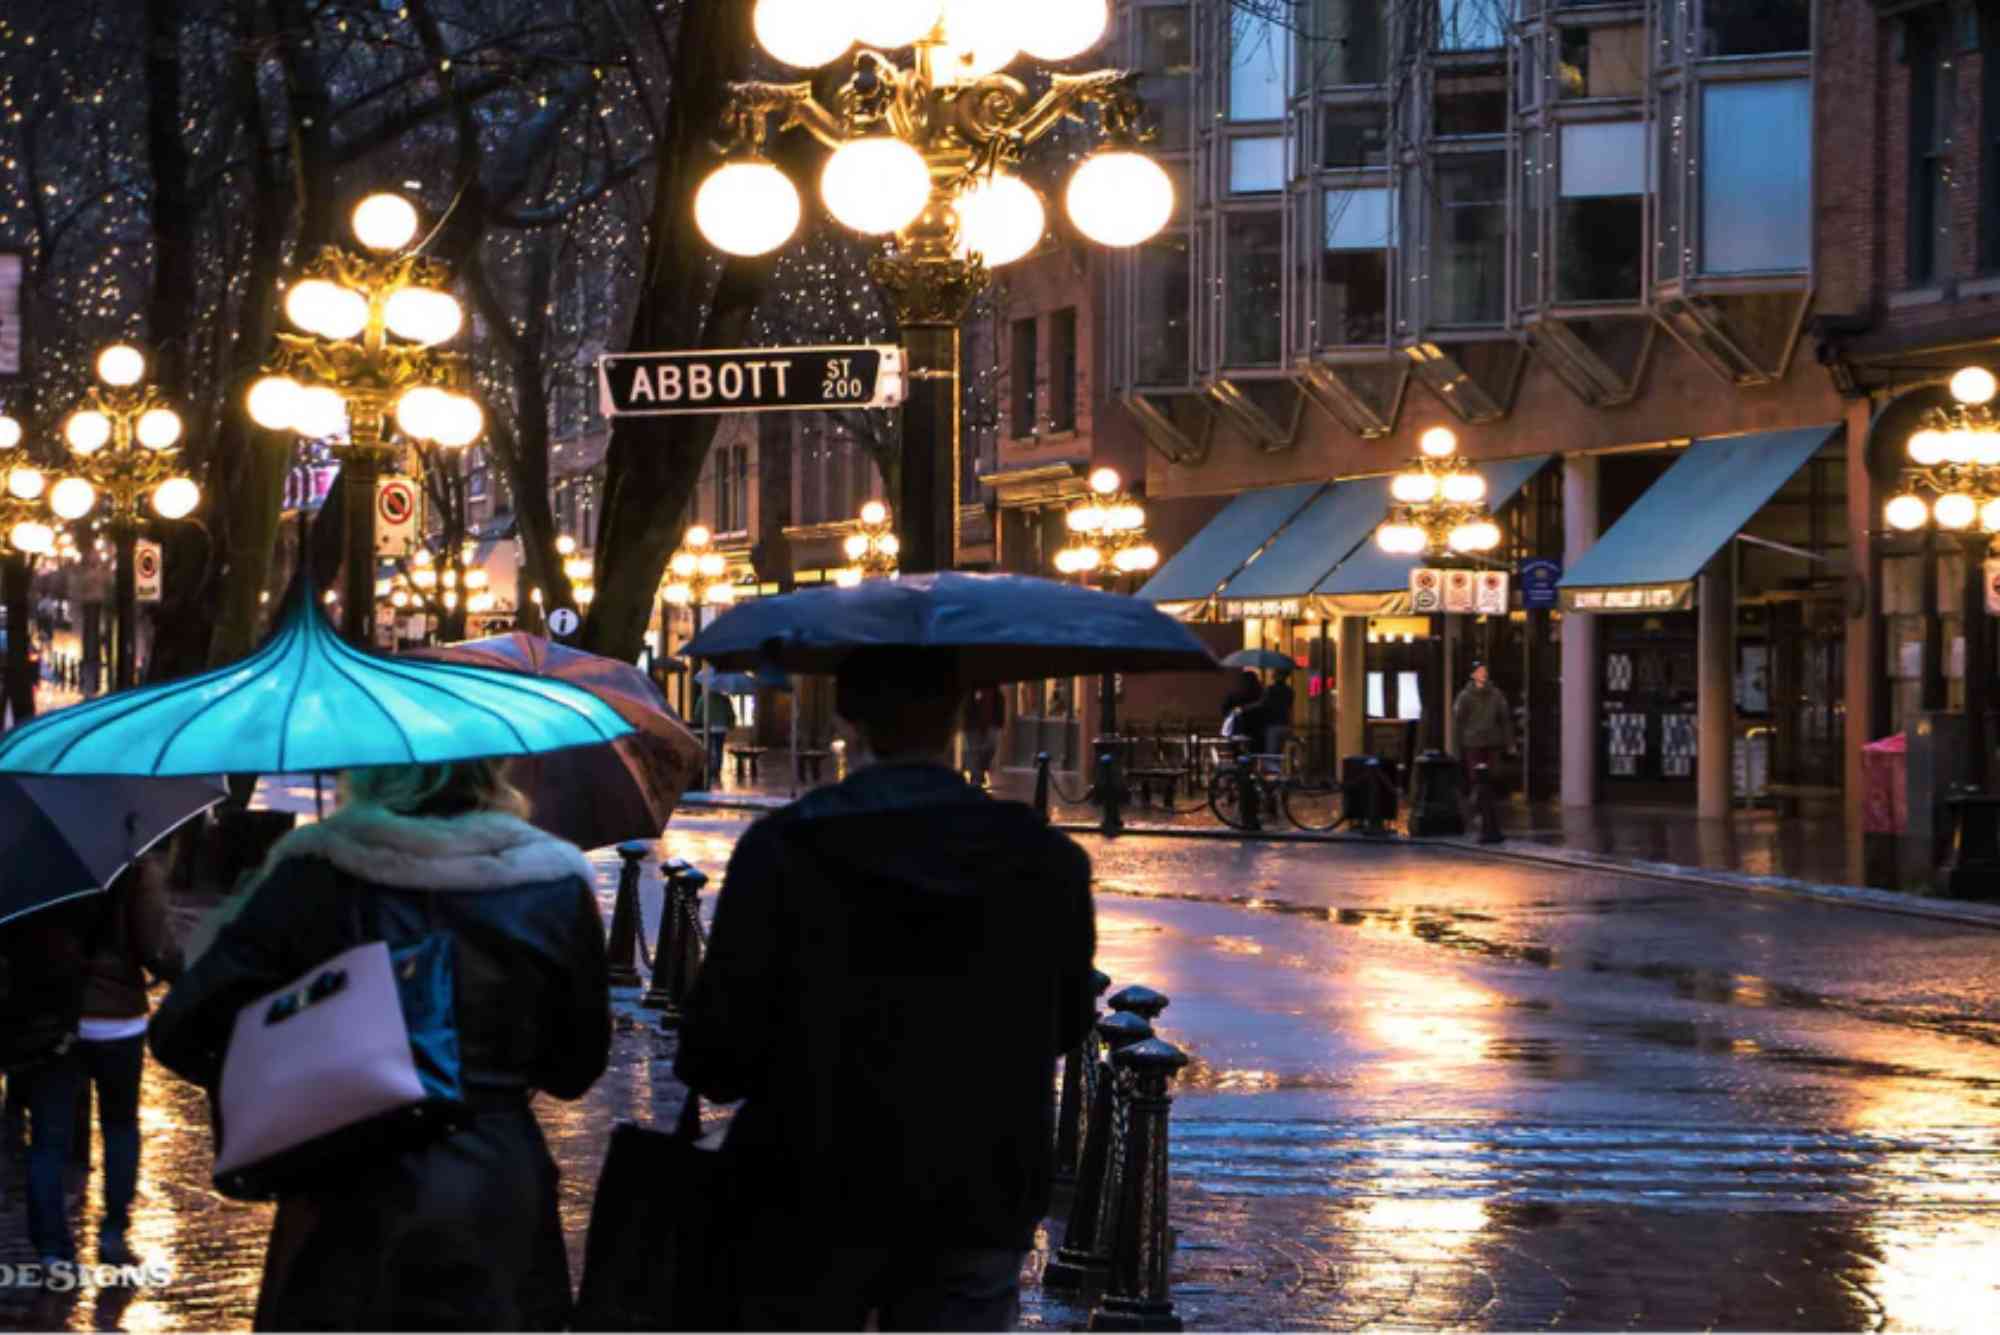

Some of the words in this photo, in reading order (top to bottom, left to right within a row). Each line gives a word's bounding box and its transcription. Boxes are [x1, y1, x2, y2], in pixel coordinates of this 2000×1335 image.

[826, 359, 851, 379] ST
[631, 361, 791, 401] ABBOTT
[822, 378, 862, 398] 200
